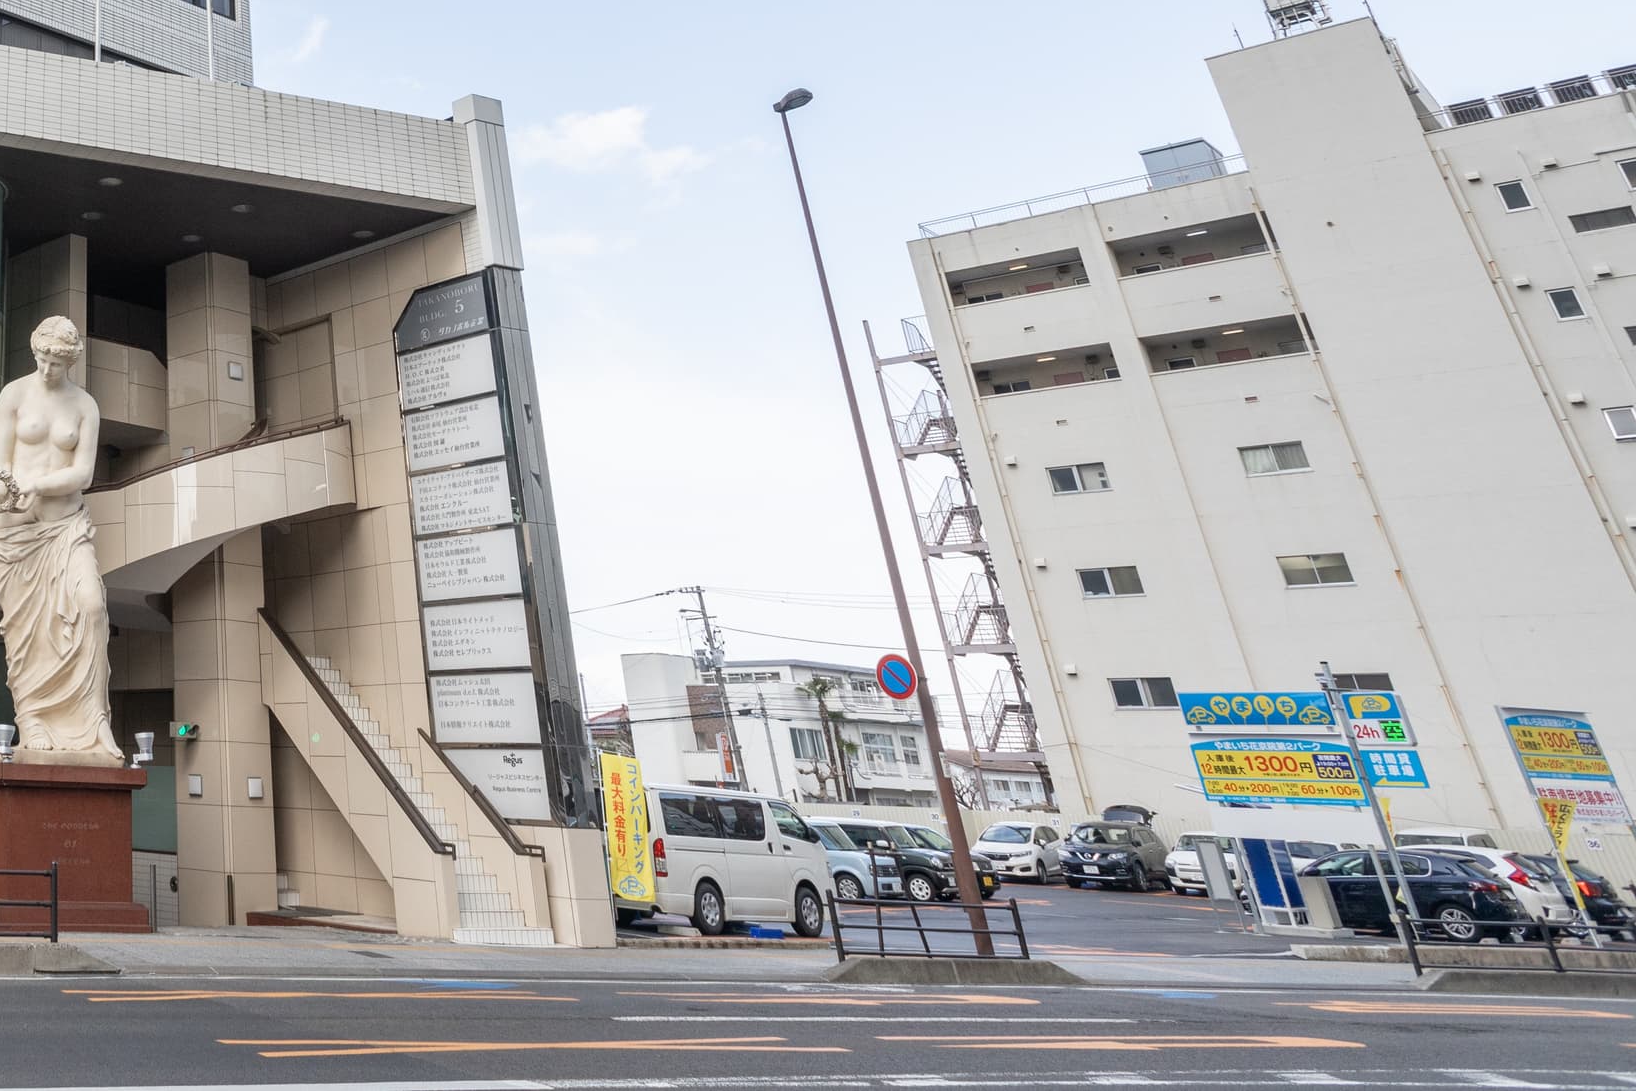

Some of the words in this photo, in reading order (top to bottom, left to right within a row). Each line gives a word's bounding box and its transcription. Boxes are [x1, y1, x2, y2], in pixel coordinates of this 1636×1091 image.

[454, 298, 465, 314] 5
[1212, 698, 1294, 713] やまいち
[1353, 724, 1381, 739] 24h
[502, 754, 524, 768] Regus
[610, 772, 627, 858] 最大料金有り
[626, 763, 645, 874] コインパーキング
